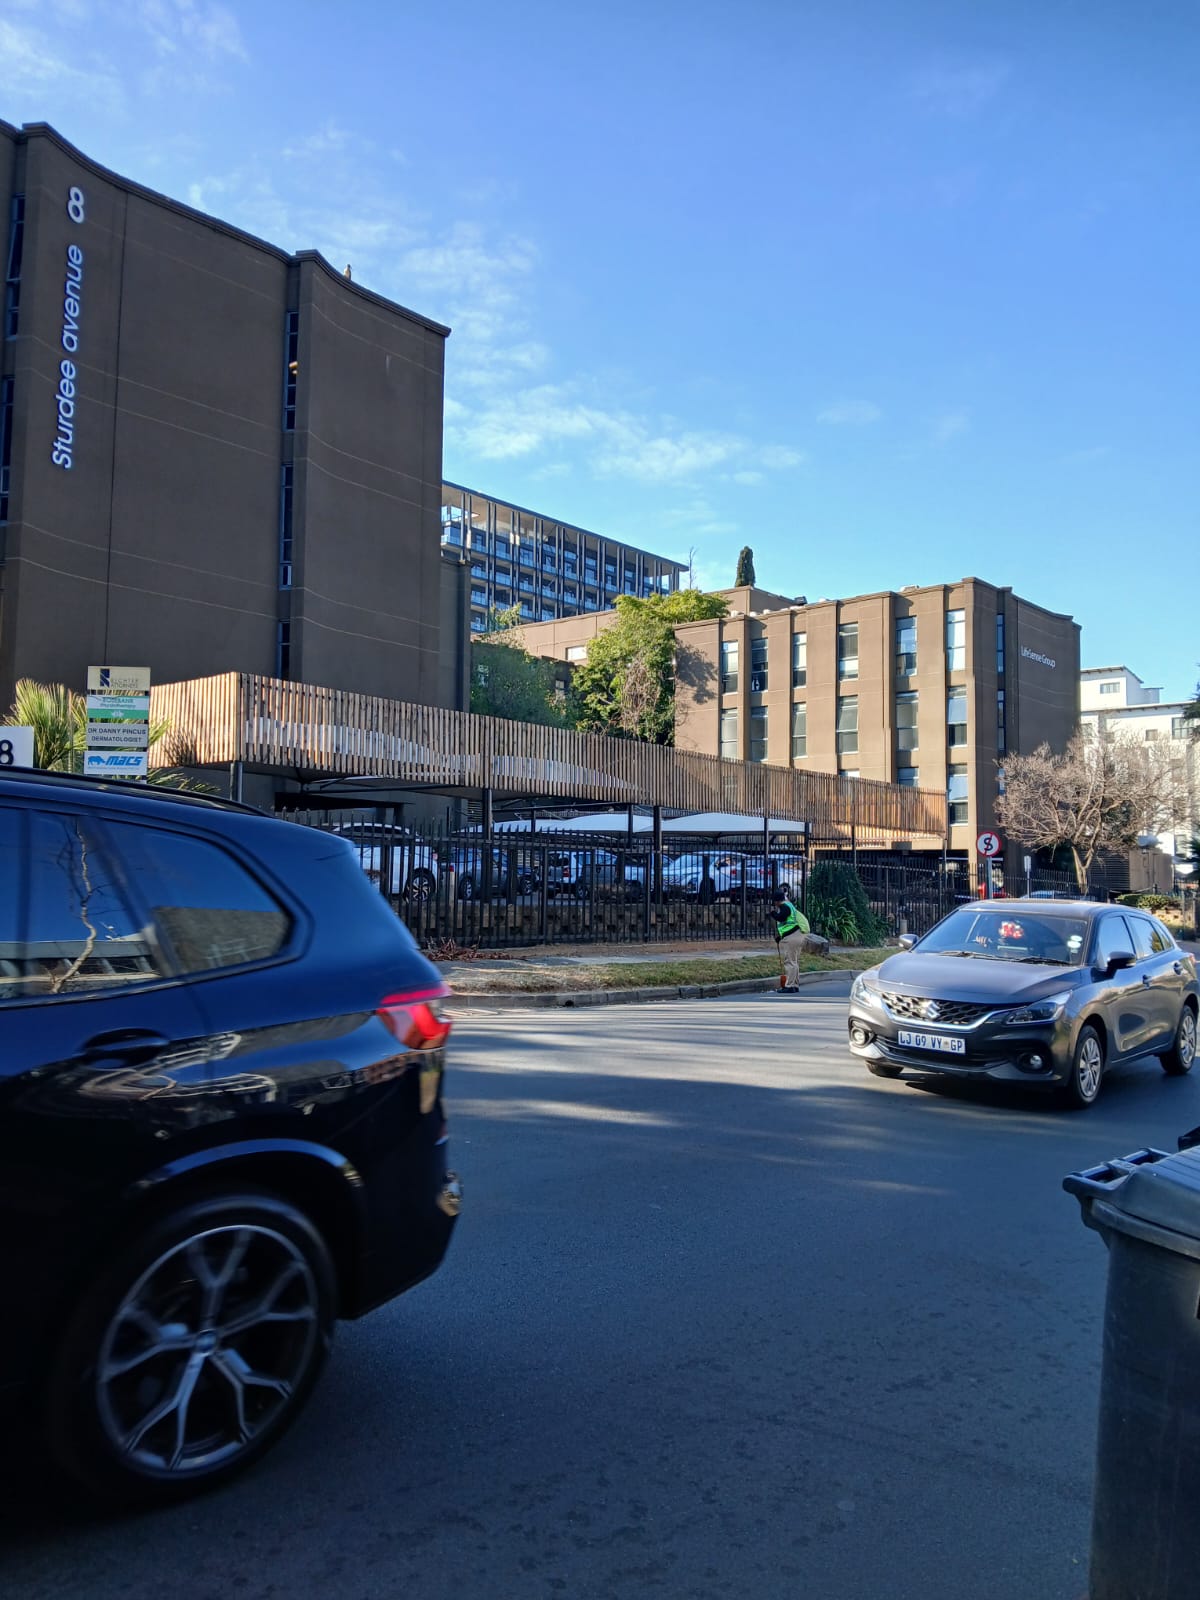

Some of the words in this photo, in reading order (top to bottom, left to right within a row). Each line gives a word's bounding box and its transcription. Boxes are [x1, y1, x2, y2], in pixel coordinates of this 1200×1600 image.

[67, 186, 85, 224] 8
[62, 244, 83, 352] avenue
[52, 359, 76, 469] Sturdee
[0, 739, 14, 765] 8
[915, 1034, 927, 1047] 09
[930, 1036, 943, 1049] VY
[950, 1039, 963, 1051] GP
